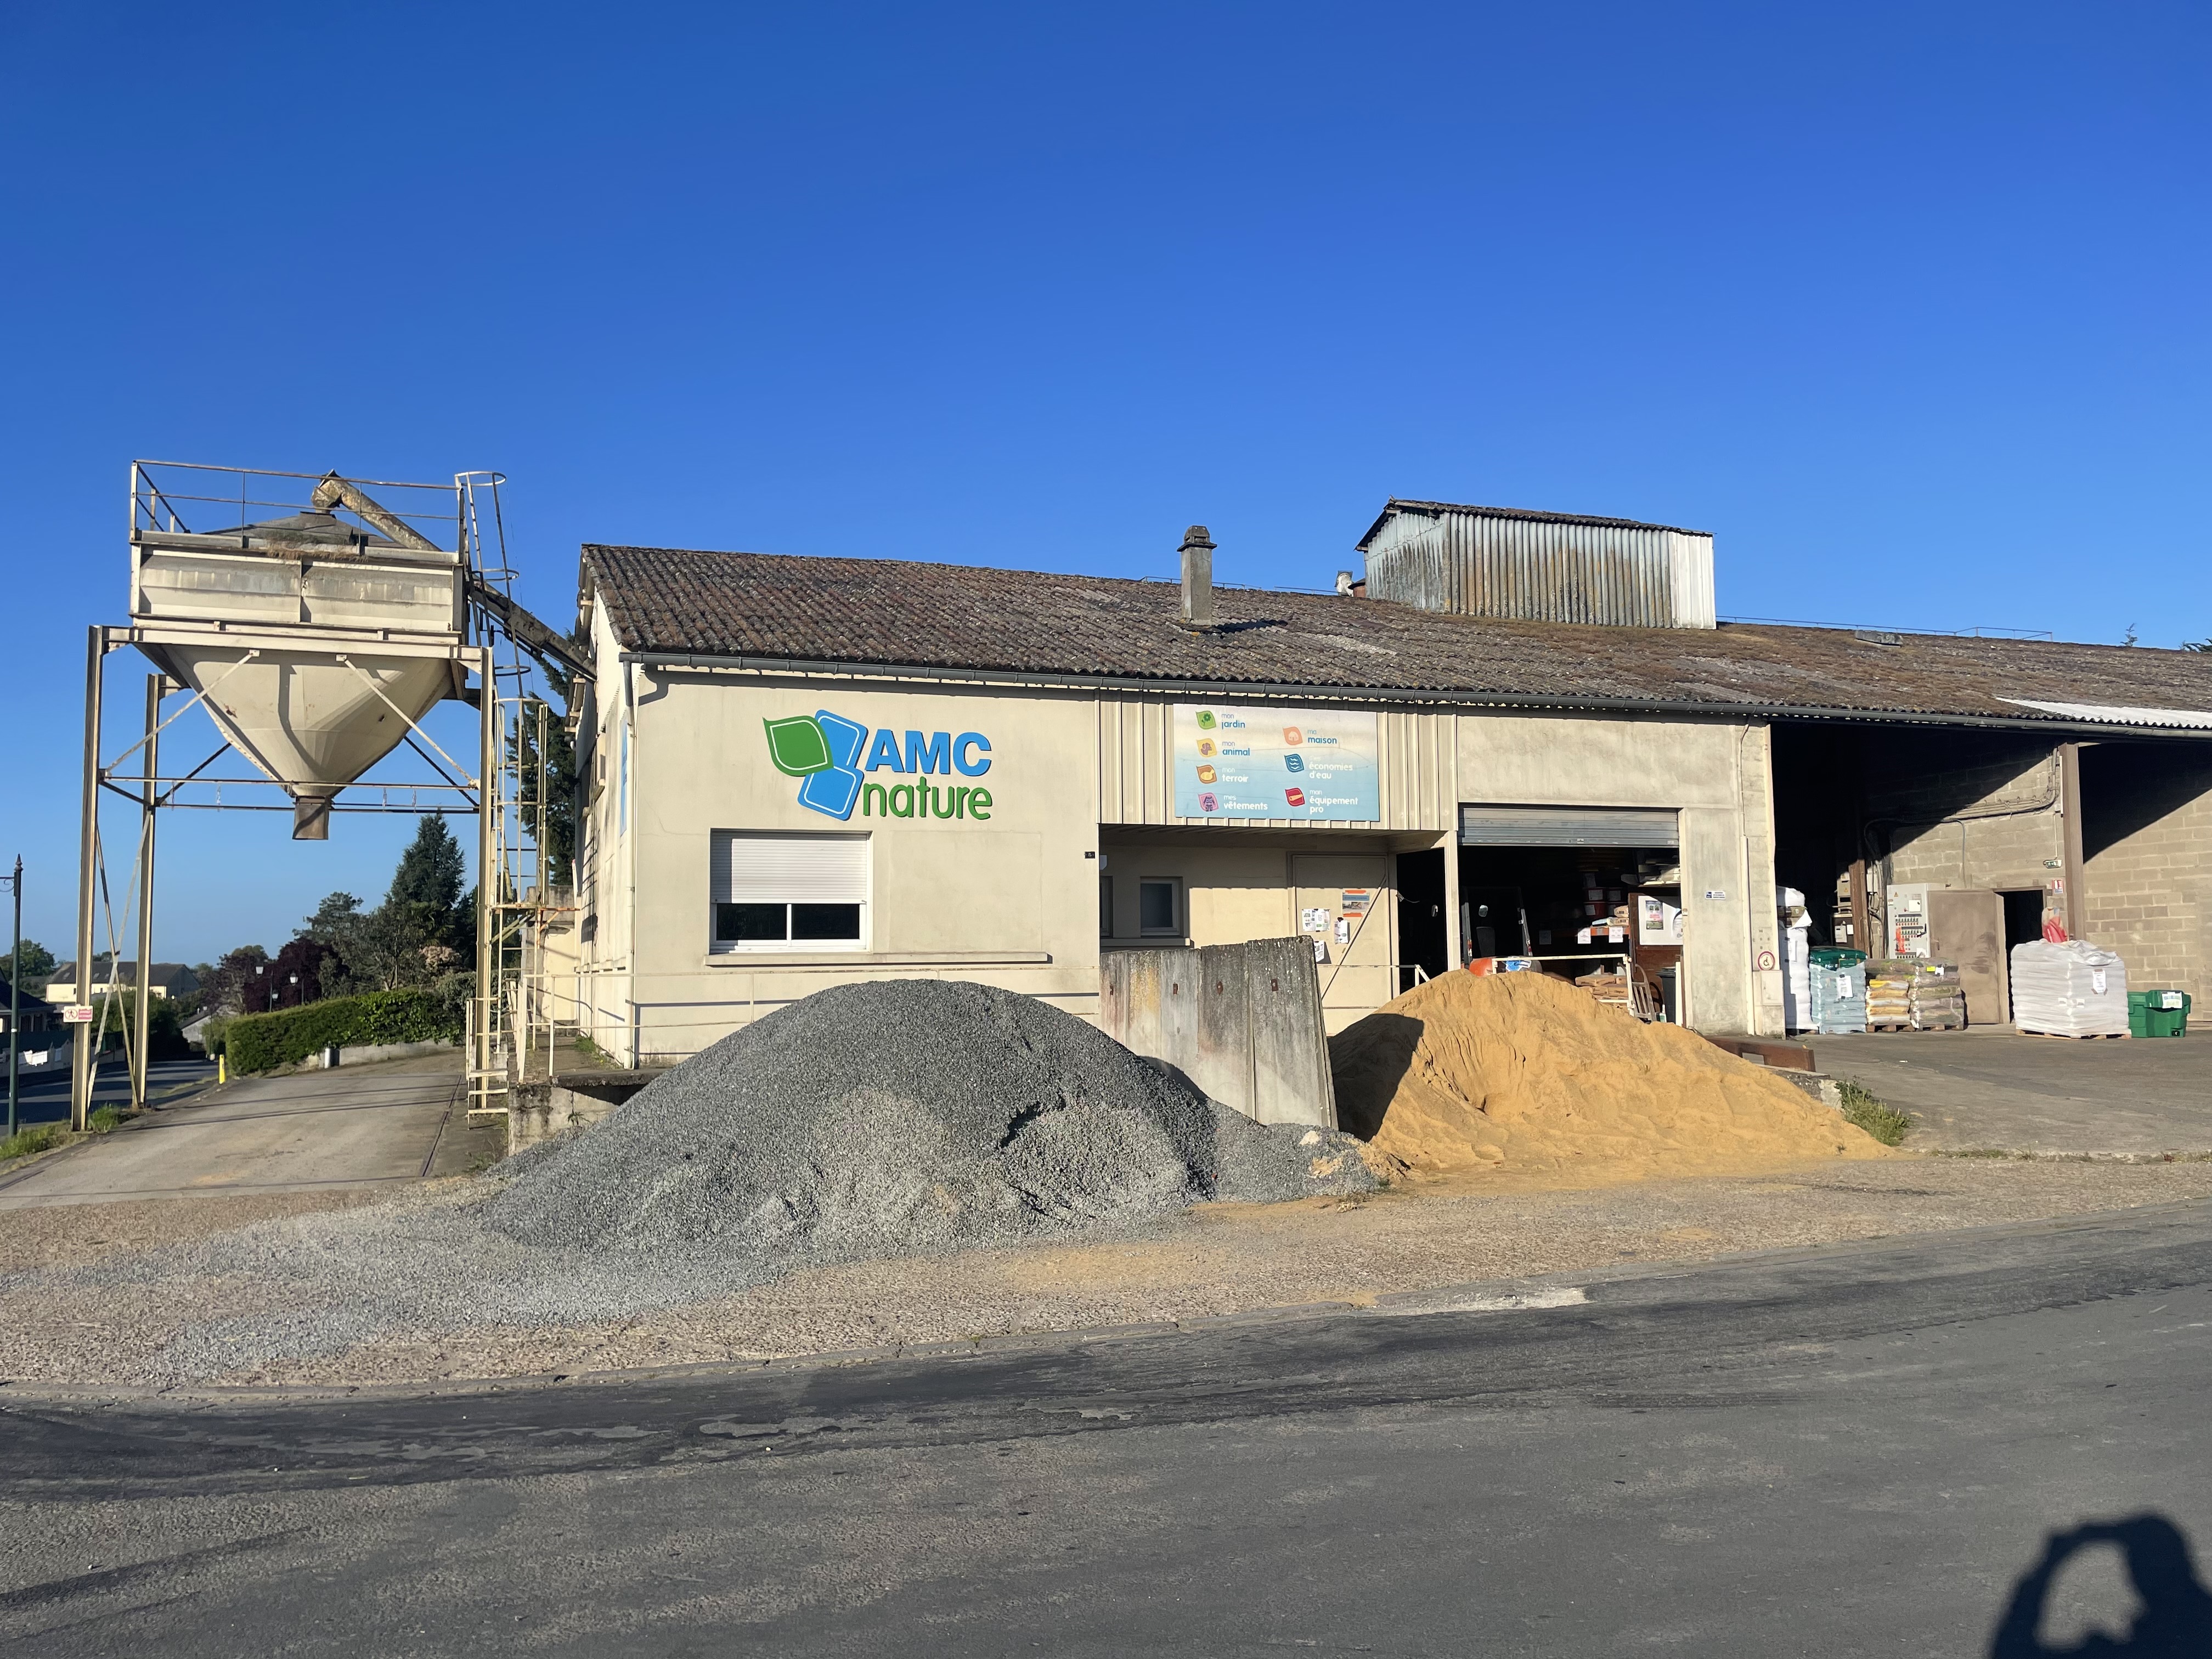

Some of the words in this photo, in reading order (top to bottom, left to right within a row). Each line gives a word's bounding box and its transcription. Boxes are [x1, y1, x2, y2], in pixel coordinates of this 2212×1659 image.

[1221, 720, 1245, 730] jardin
[865, 729, 992, 777] AMC
[1222, 748, 1250, 756] animal
[1308, 761, 1353, 771] économies
[1222, 774, 1249, 782] terroir
[863, 776, 992, 820] nature
[1309, 796, 1358, 806] équipement
[1223, 801, 1268, 810] vêtements
[1310, 806, 1324, 815] pro
